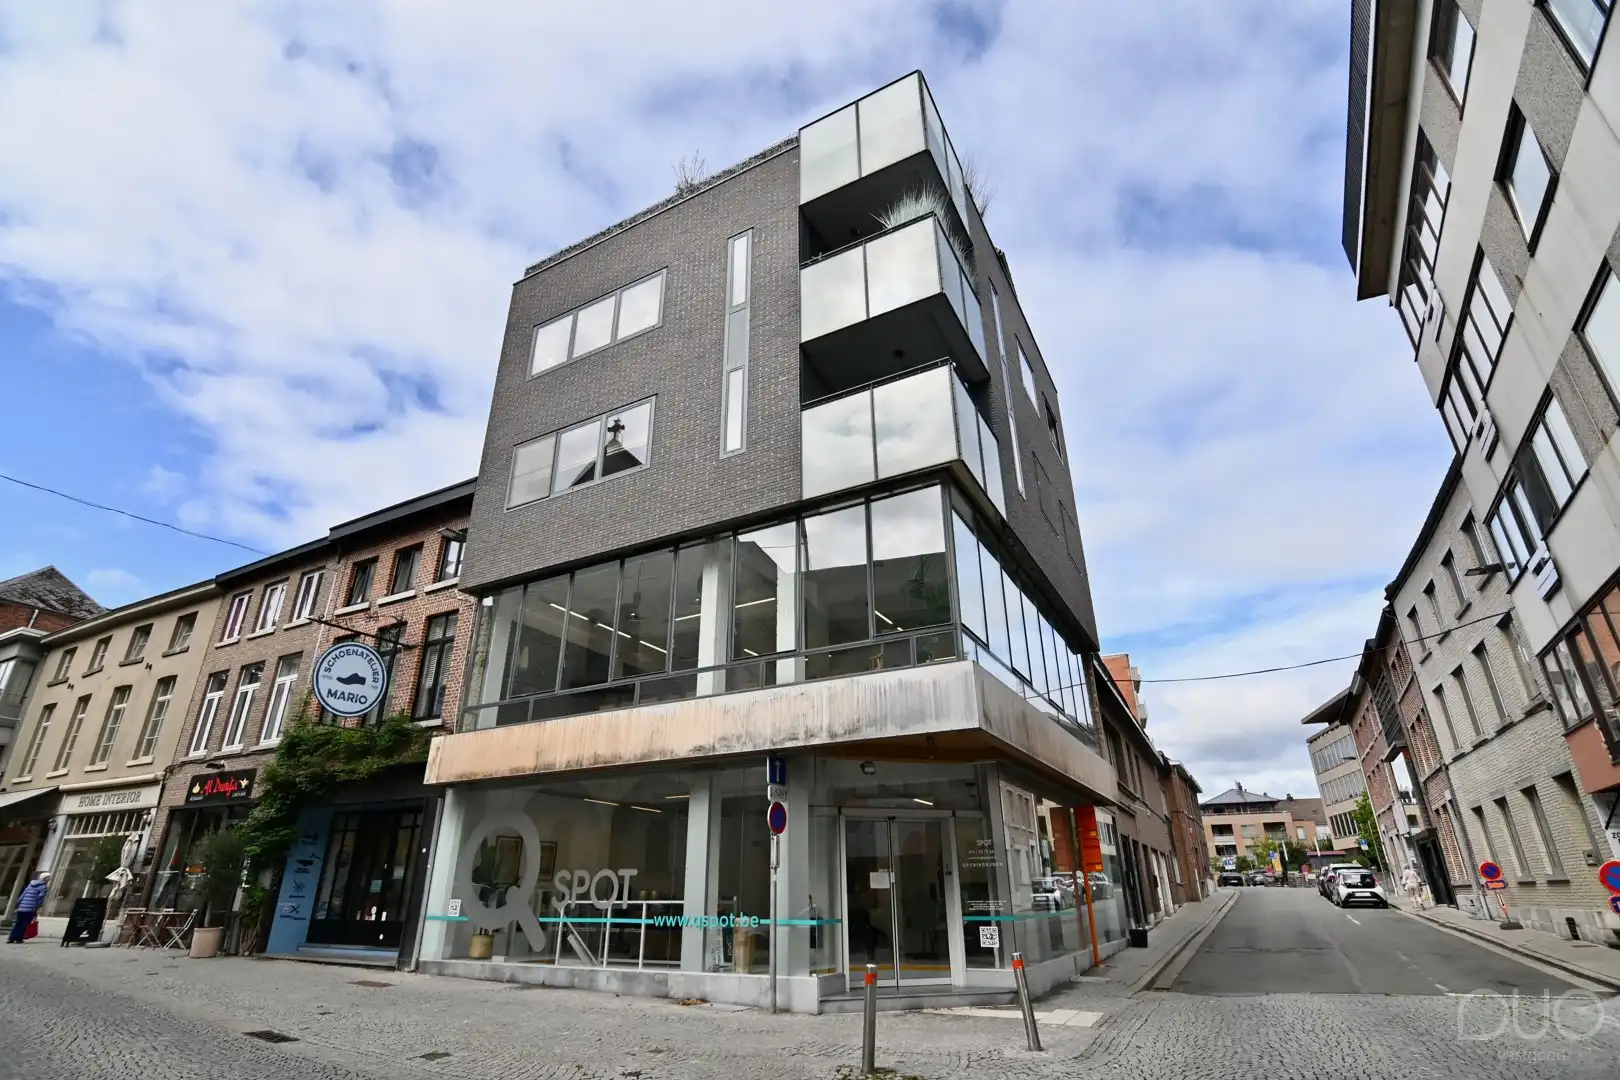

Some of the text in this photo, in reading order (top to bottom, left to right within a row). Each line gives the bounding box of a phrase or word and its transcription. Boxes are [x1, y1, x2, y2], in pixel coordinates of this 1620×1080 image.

[324, 648, 380, 684] SCHOENATELIER
[326, 688, 368, 705] MARIO
[78, 791, 141, 807] HOME INTERIOR
[551, 868, 639, 910] SPOT
[653, 911, 760, 930] www.qspot.be
